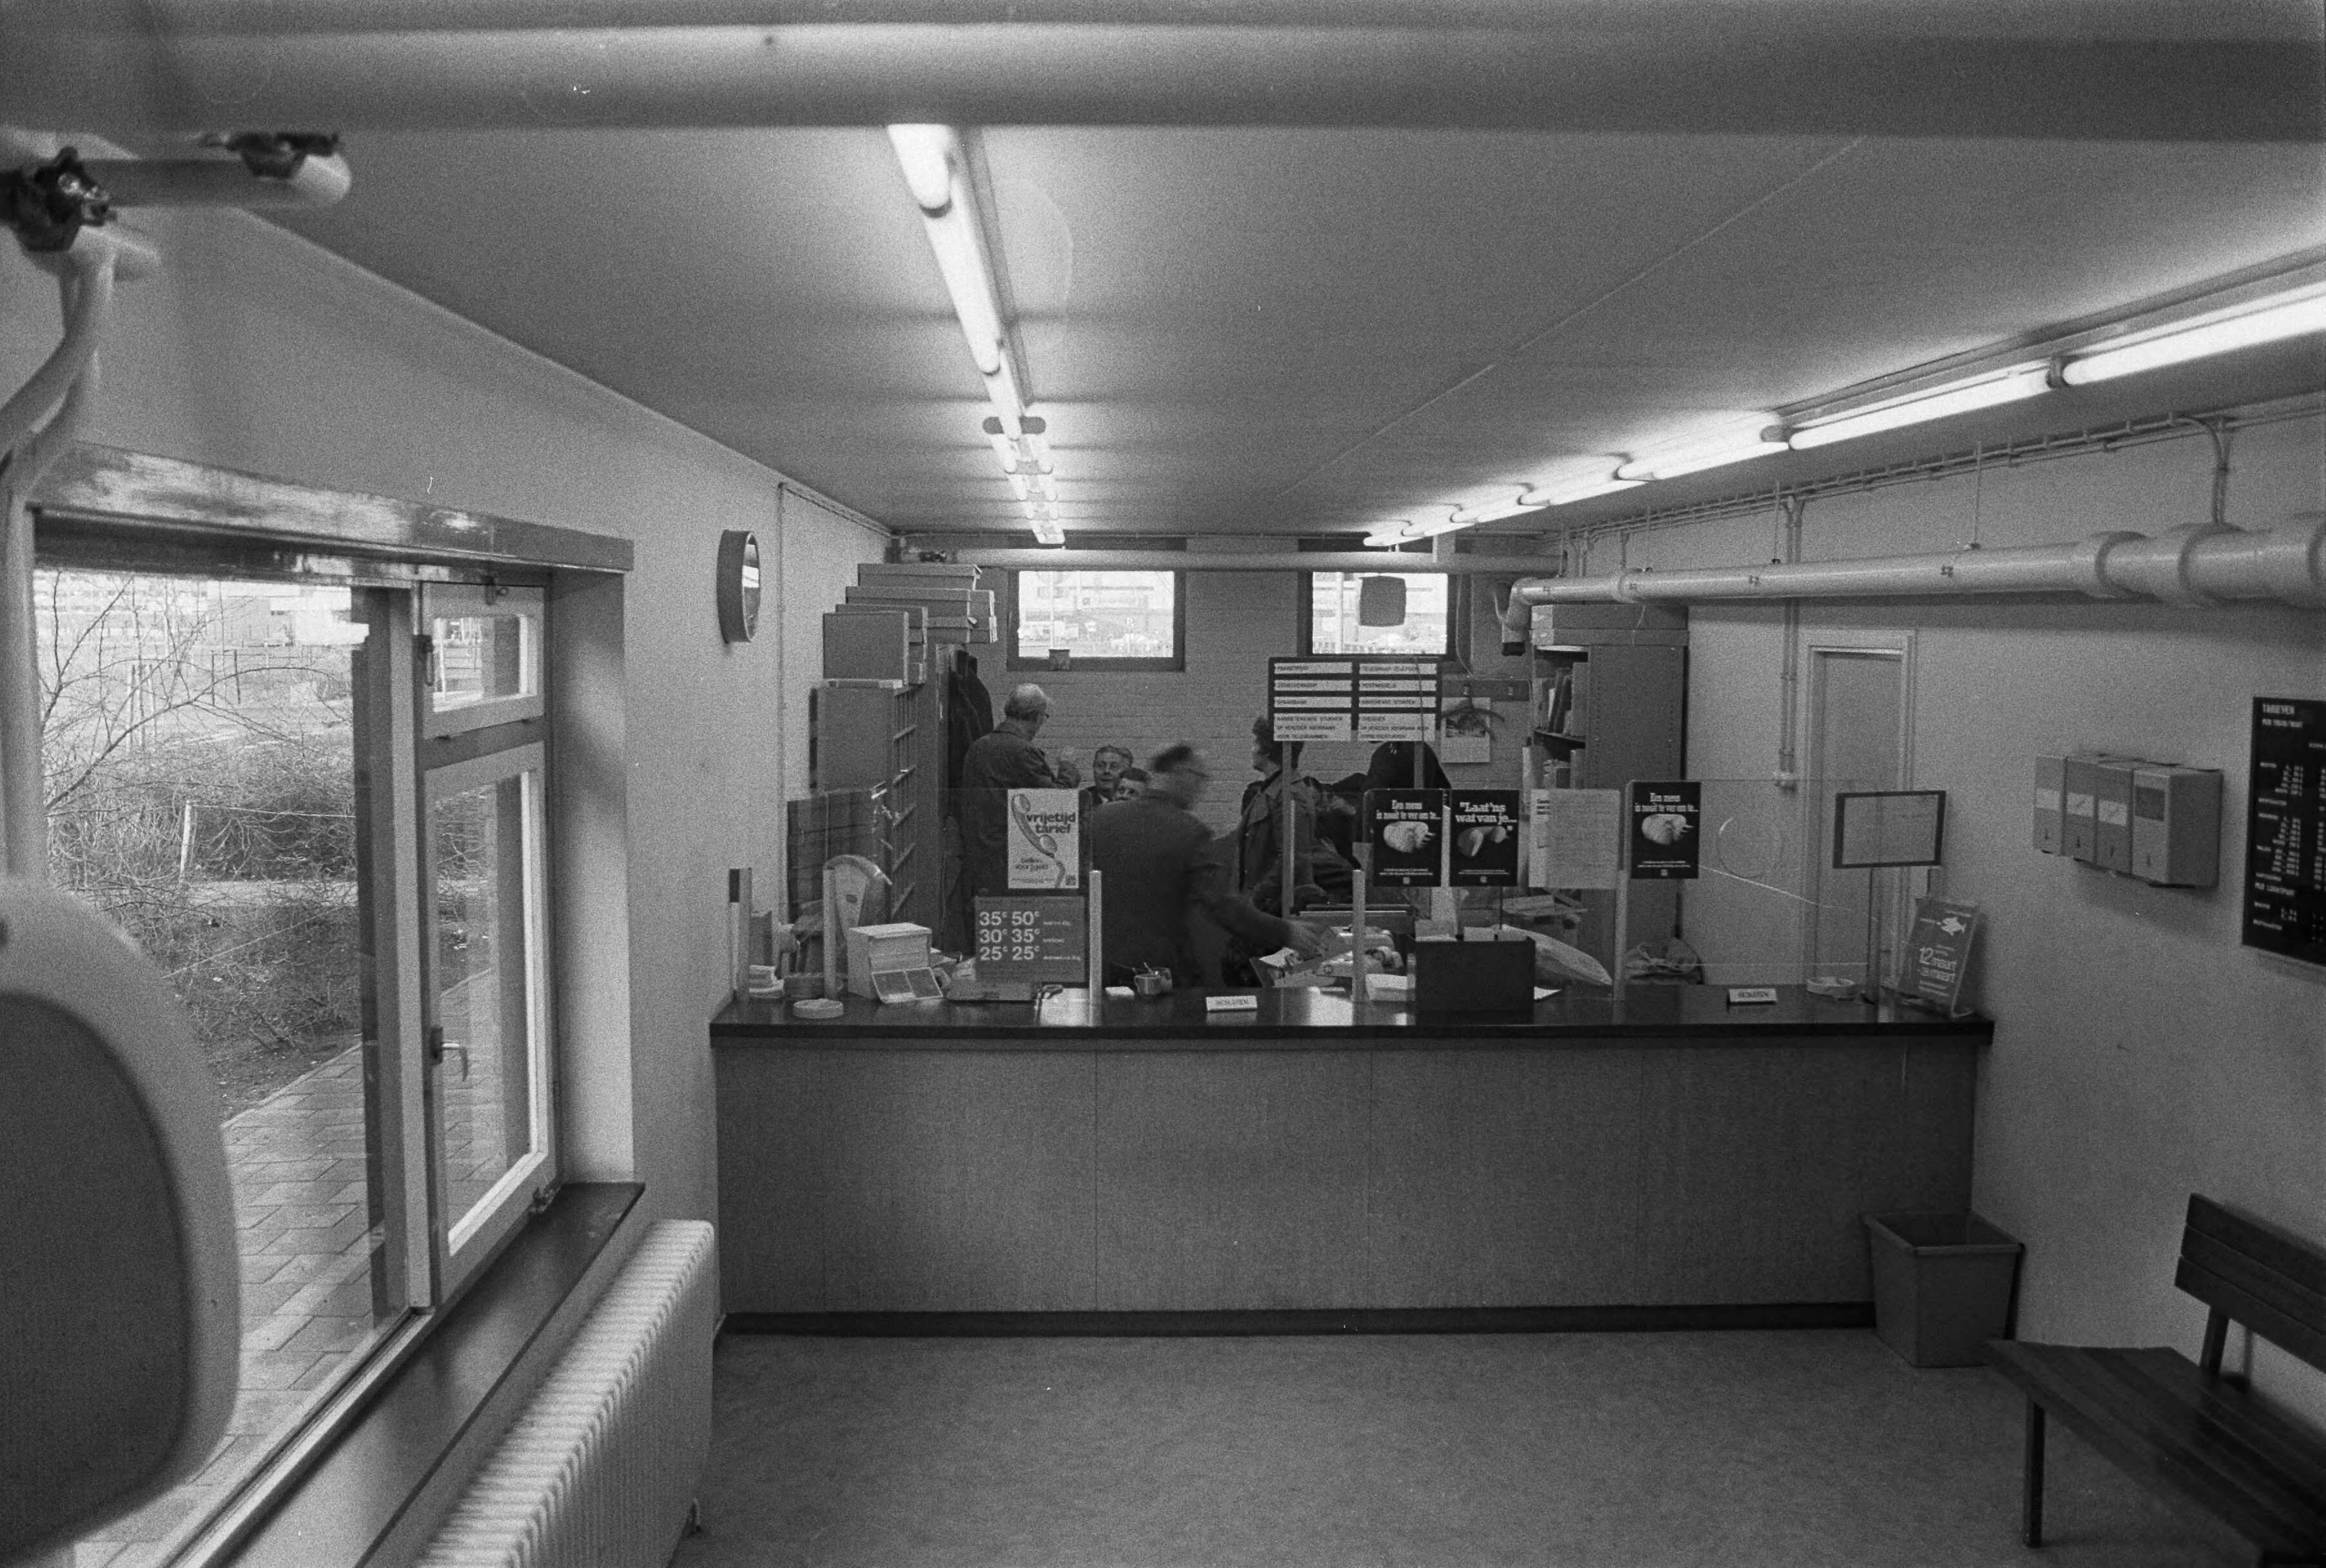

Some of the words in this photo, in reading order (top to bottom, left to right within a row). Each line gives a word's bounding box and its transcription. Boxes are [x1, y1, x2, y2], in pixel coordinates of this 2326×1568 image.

[1026, 811, 1075, 825] vrijetijd
[1455, 814, 1476, 823] wat
[1476, 814, 1497, 823] van
[1035, 824, 1071, 834] tarief
[1919, 947, 1933, 965] 12
